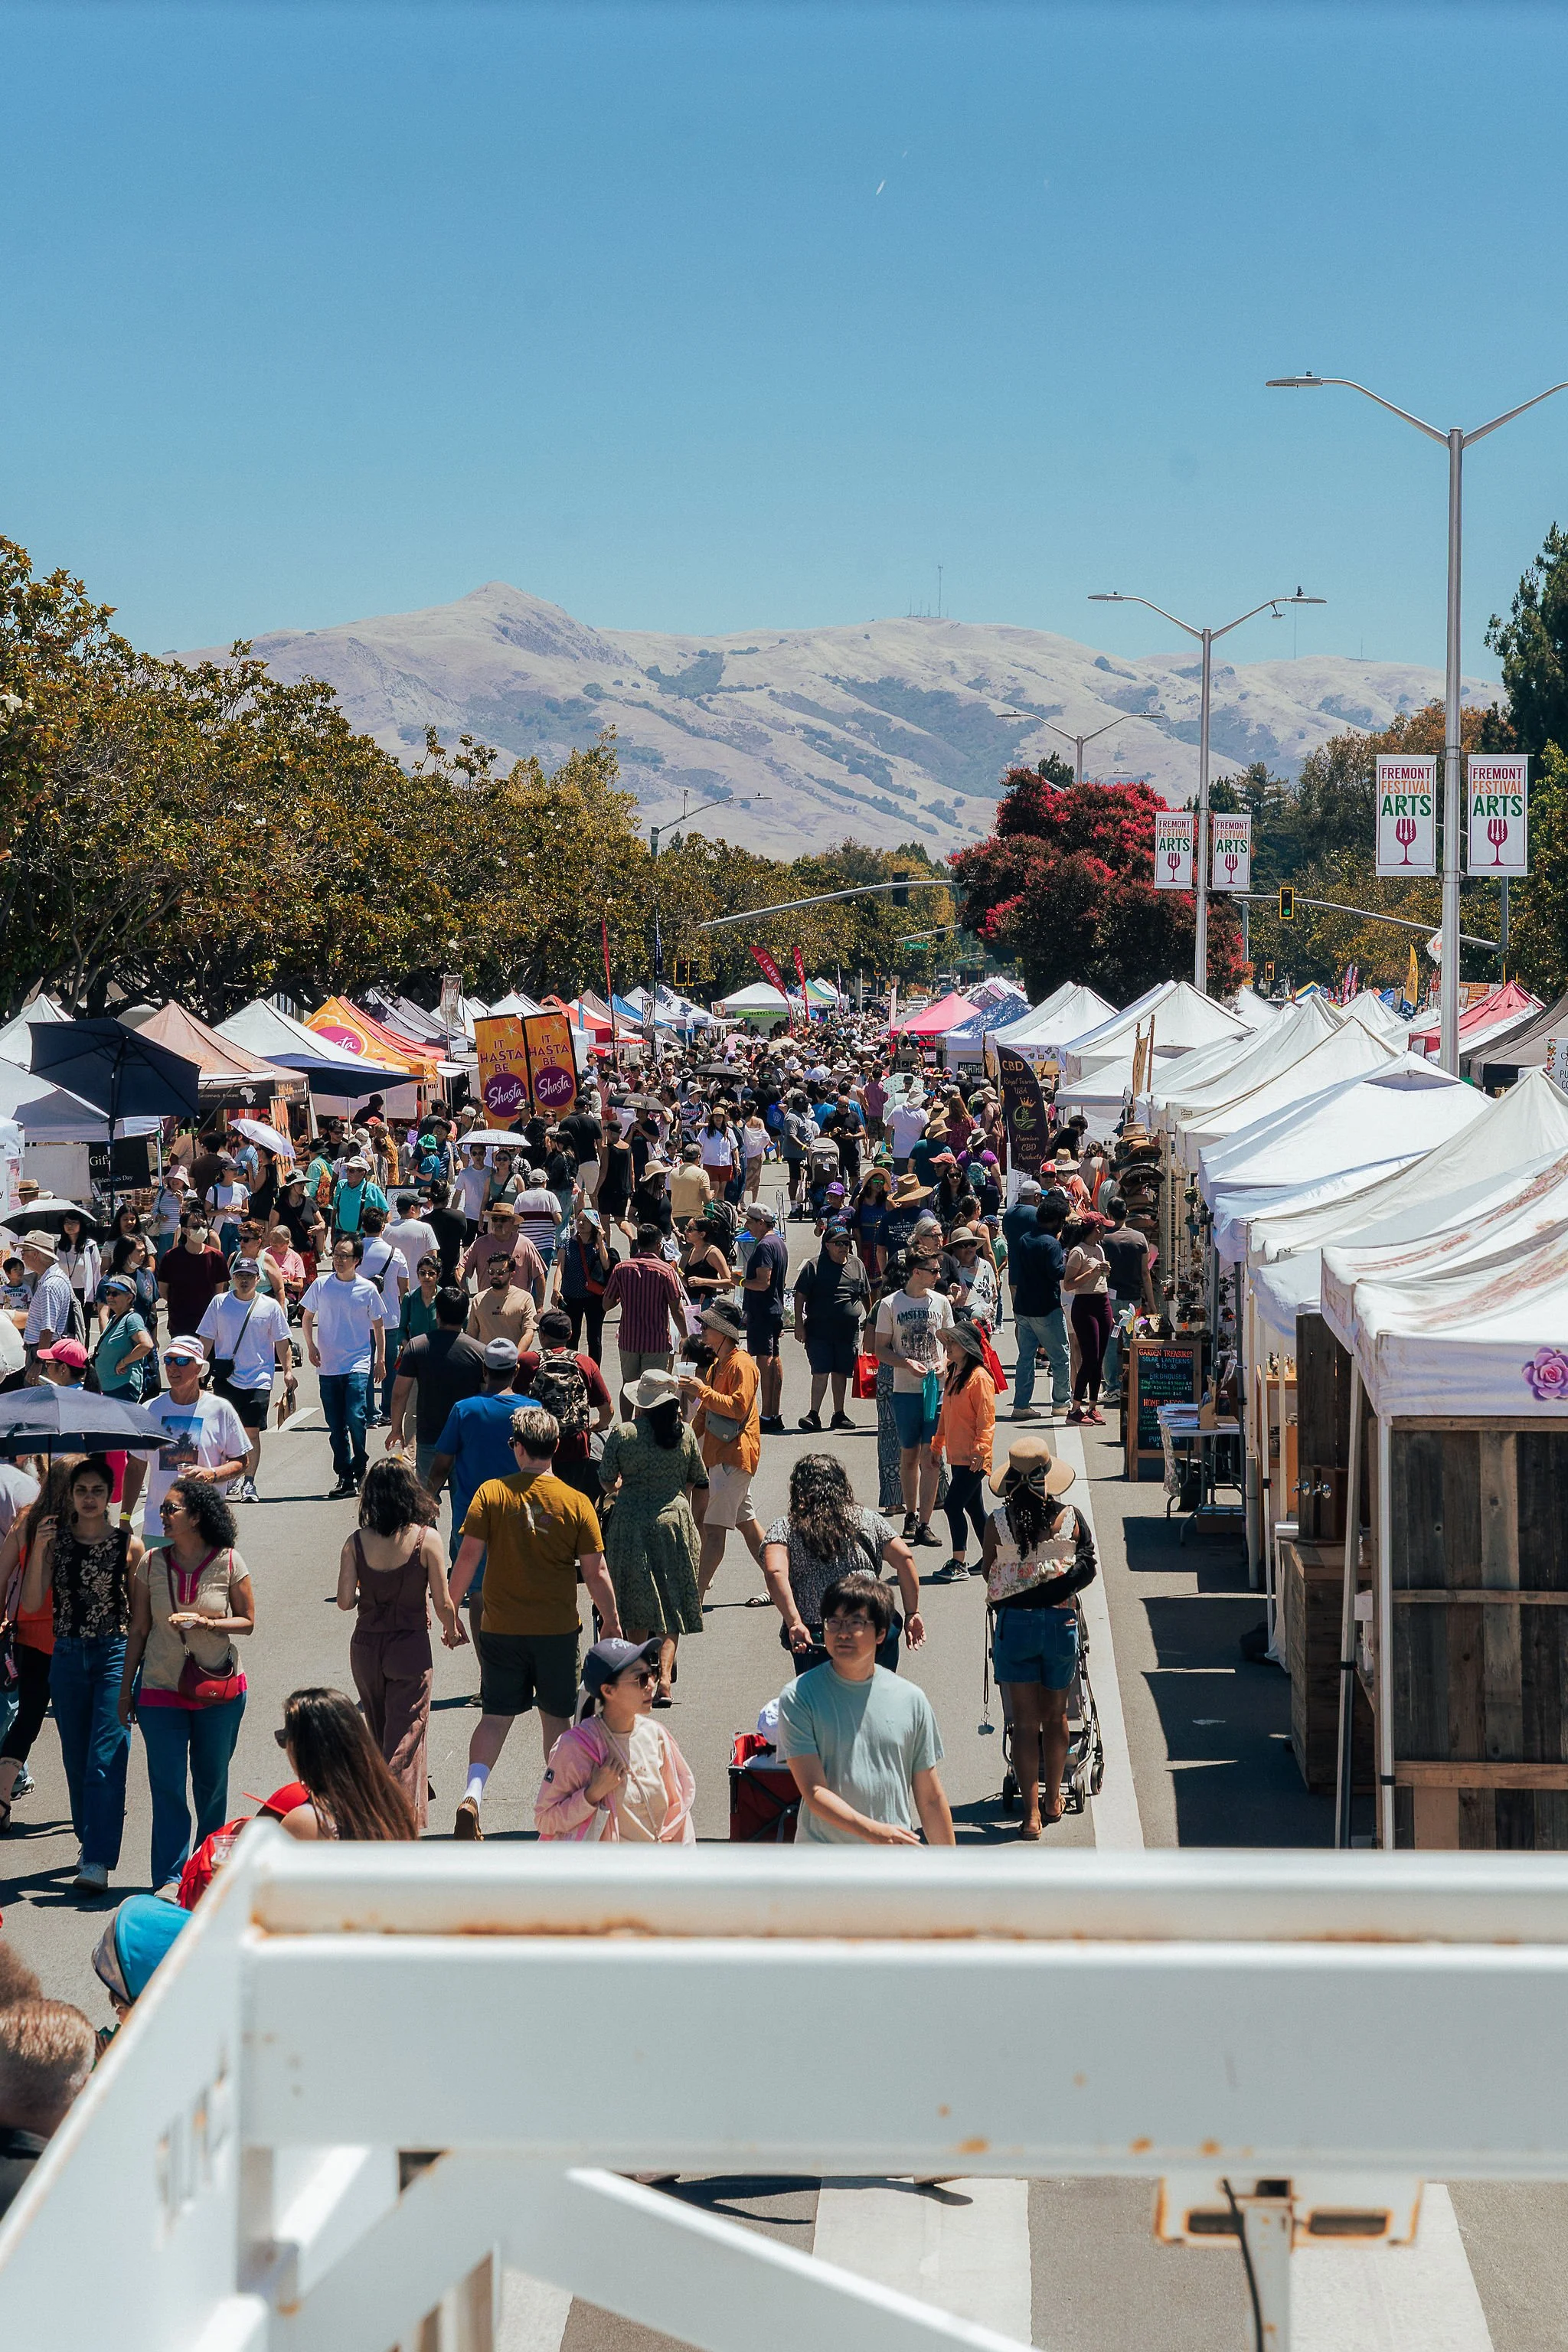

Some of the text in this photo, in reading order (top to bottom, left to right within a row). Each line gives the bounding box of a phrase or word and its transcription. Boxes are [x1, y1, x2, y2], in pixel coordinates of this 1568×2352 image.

[1382, 767, 1432, 779] FREMONT
[1473, 768, 1523, 779] FREMONT
[1381, 780, 1432, 794] FESTIVAL
[1472, 780, 1523, 794] FESTIVAL
[1381, 795, 1432, 817] ARTS
[1472, 795, 1523, 817] ARTS
[1158, 828, 1191, 838] FESTIVAL
[1217, 830, 1248, 839] FESTIVAL
[1158, 838, 1191, 851] ARTS
[1216, 839, 1248, 853] ARTS
[766, 964, 781, 983] BAR
[494, 1039, 505, 1050] IT
[541, 1034, 551, 1044] IT
[479, 1048, 524, 1063] HASTA
[528, 1044, 570, 1057] HASTA
[495, 1063, 509, 1073] BE
[543, 1057, 557, 1066] BE
[1002, 1060, 1024, 1071] CBD
[538, 1074, 572, 1099] Shasta
[1004, 1077, 1018, 1086] Royal
[488, 1082, 524, 1109] Shasta
[897, 1309, 943, 1326] AMSTERDAM
[1139, 1348, 1161, 1357] GARDEN
